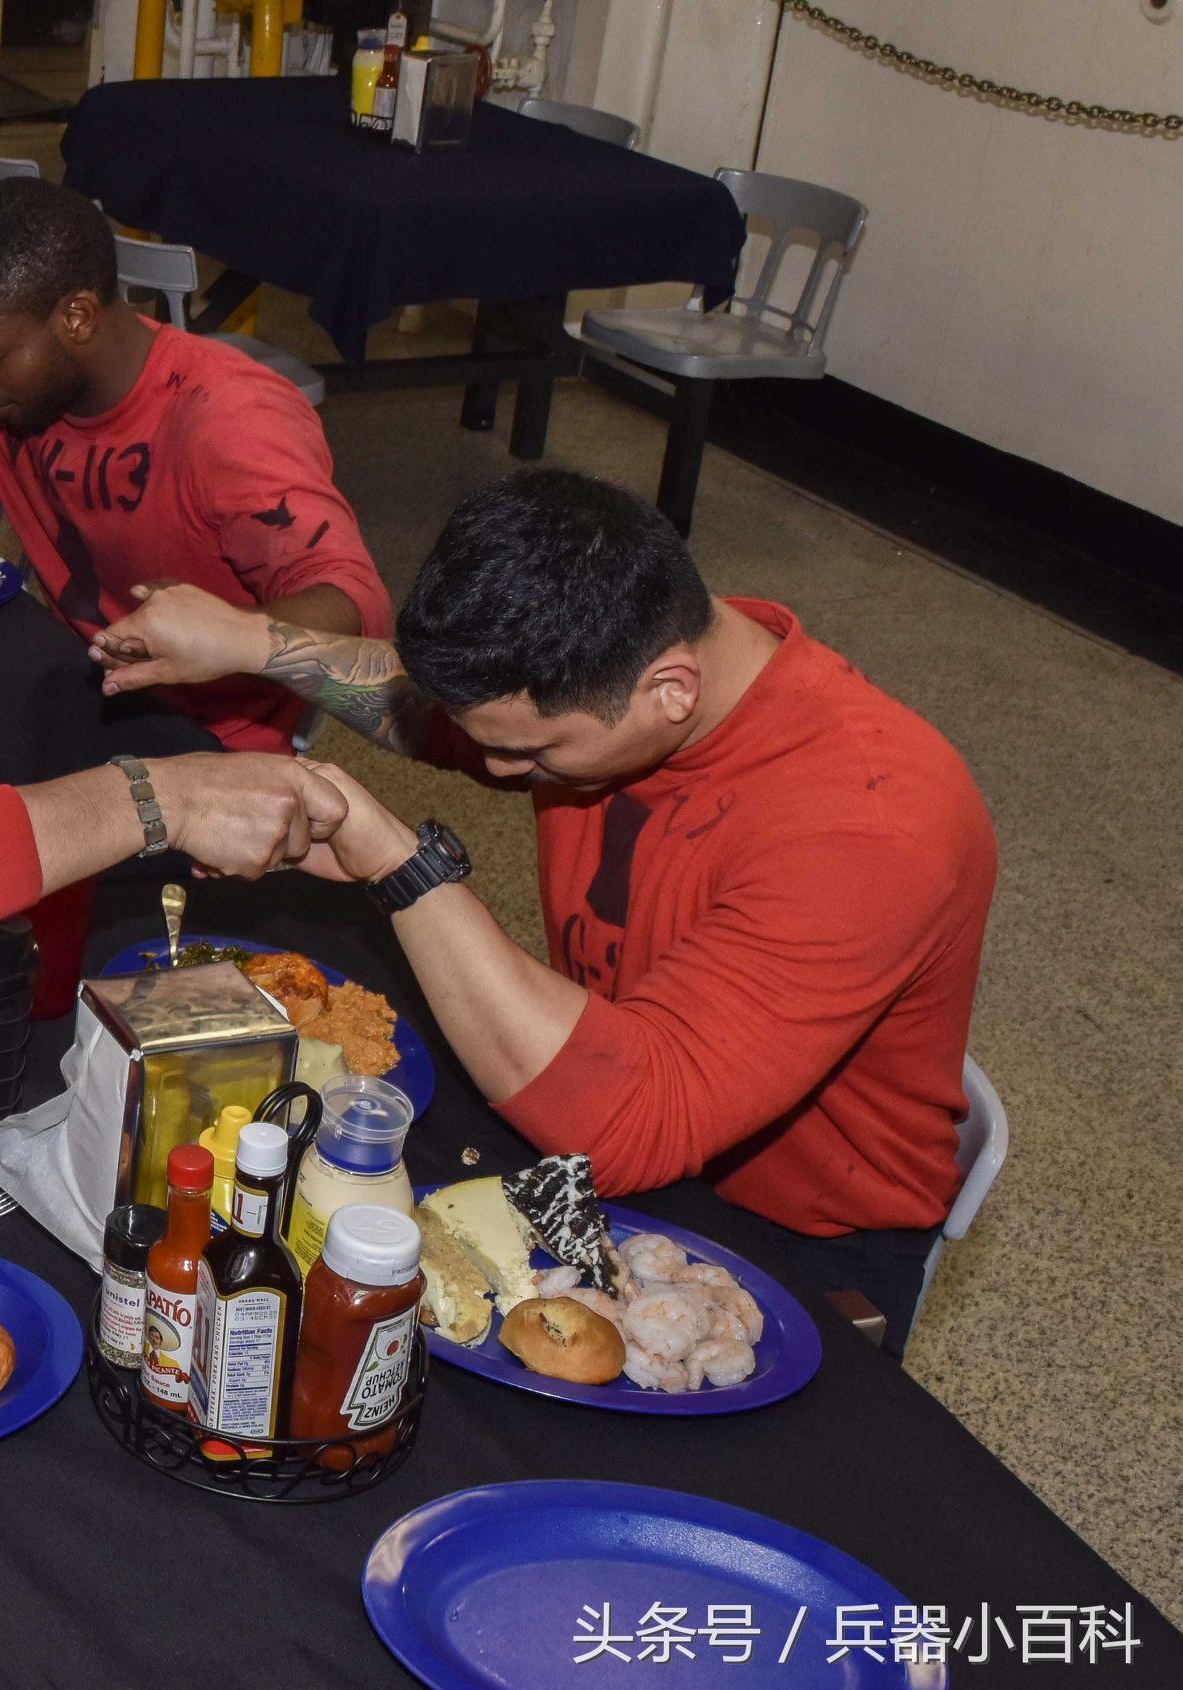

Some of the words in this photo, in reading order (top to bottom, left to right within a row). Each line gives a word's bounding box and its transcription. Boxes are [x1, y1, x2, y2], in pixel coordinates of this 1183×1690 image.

[150, 1374, 170, 1388] Sauce
[361, 1371, 404, 1400] TOMATO
[365, 1361, 405, 1387] KETCHUP
[157, 1387, 168, 1397] 148
[170, 1391, 183, 1399] mL
[364, 1394, 396, 1418] HEINZ
